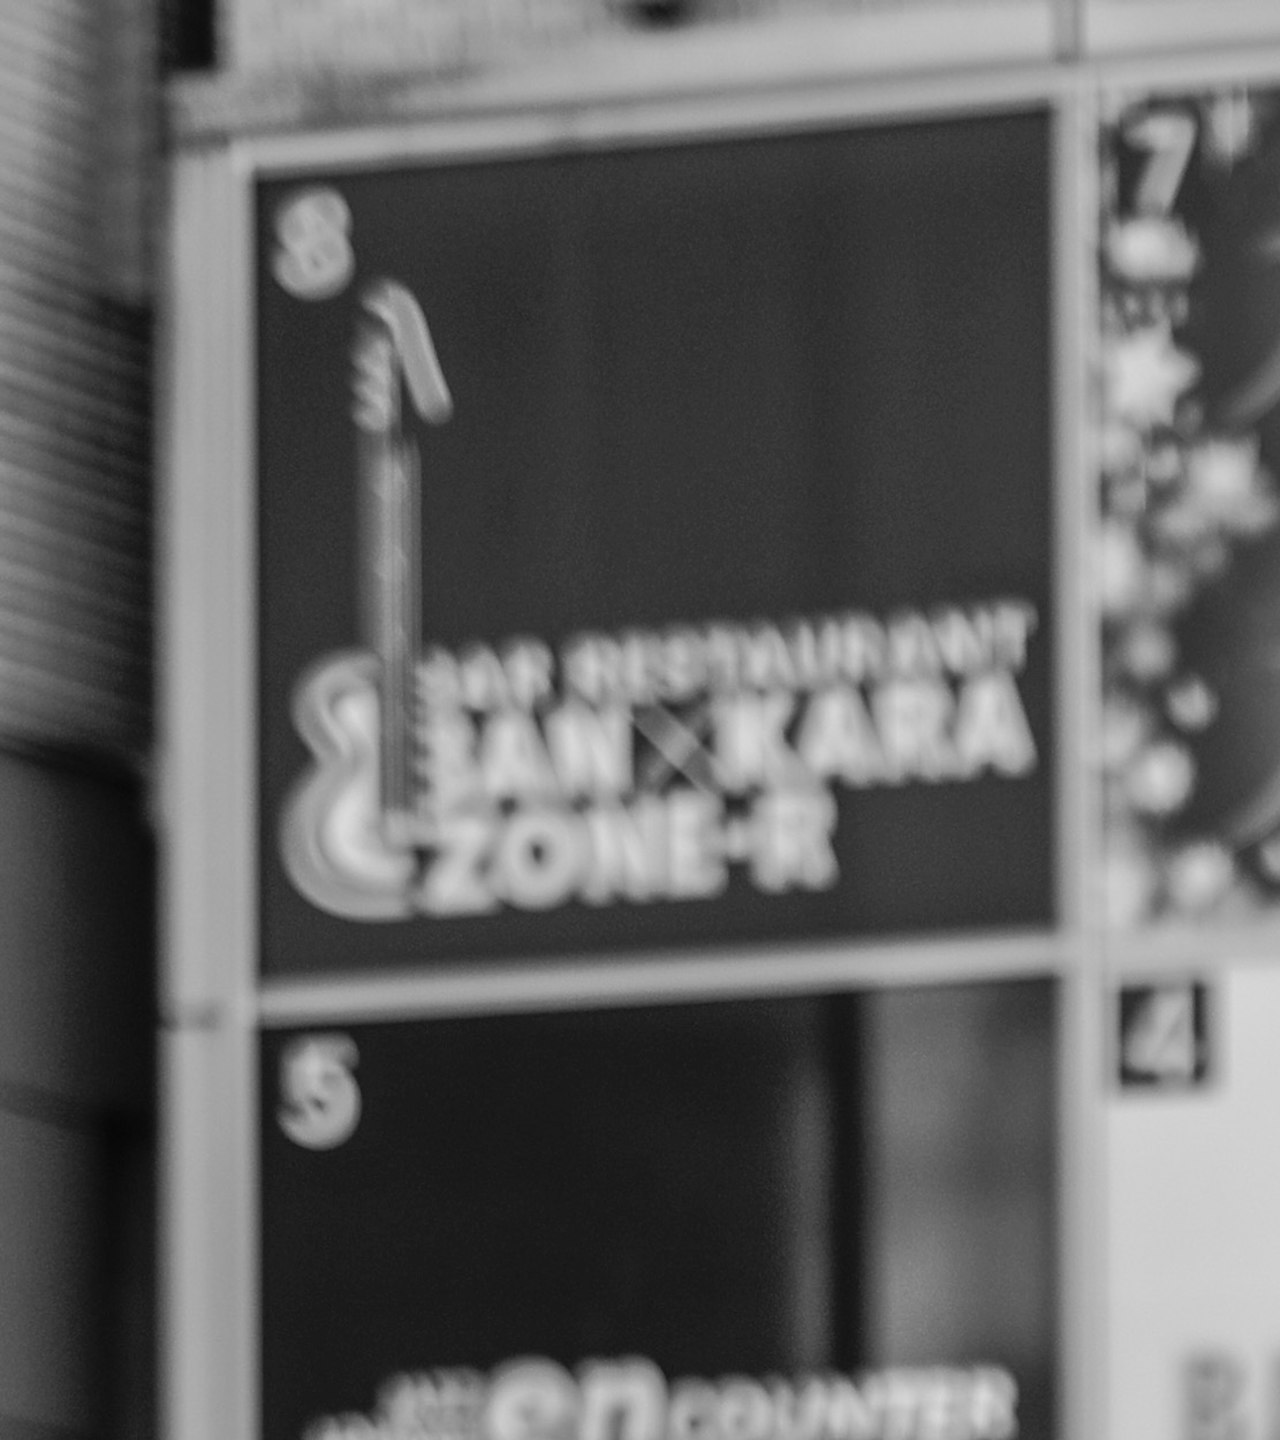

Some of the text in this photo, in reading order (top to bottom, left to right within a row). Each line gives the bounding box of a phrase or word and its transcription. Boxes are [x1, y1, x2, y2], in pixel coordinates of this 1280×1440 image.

[1117, 113, 1196, 213] 7
[274, 186, 354, 300] 8
[1125, 985, 1197, 1080] 4
[276, 1032, 362, 1150] 5
